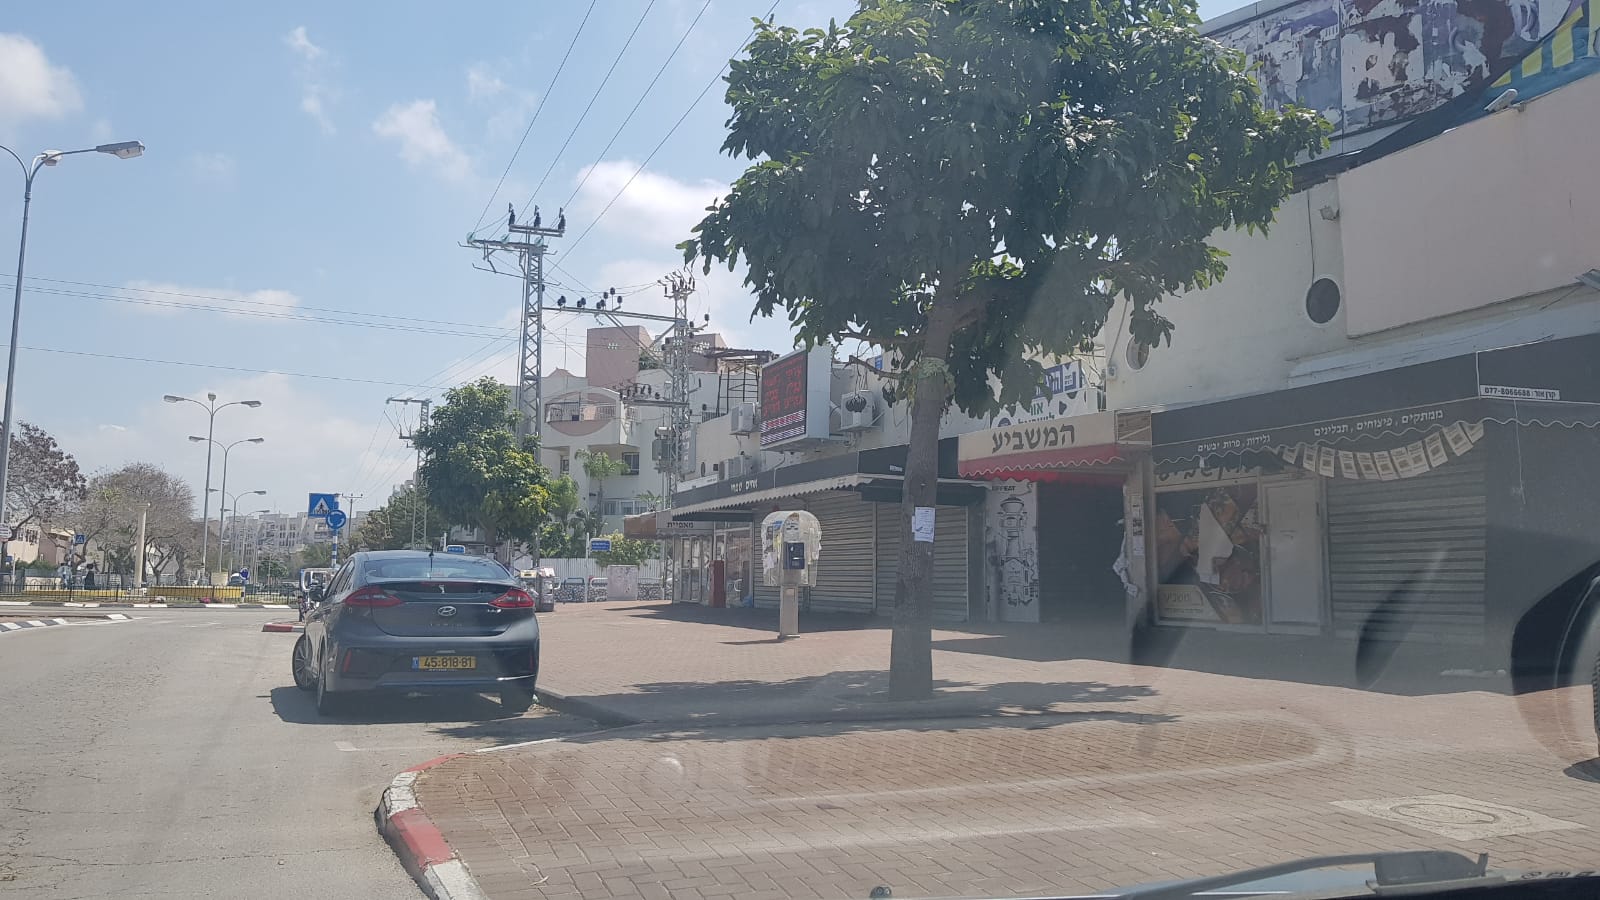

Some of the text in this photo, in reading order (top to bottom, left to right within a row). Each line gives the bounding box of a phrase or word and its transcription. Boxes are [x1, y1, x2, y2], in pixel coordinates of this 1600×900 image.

[1313, 424, 1349, 437] תבלינים
[991, 424, 1075, 454] המשביע
[1223, 439, 1241, 449] פרות
[1197, 441, 1220, 452] יבשים
